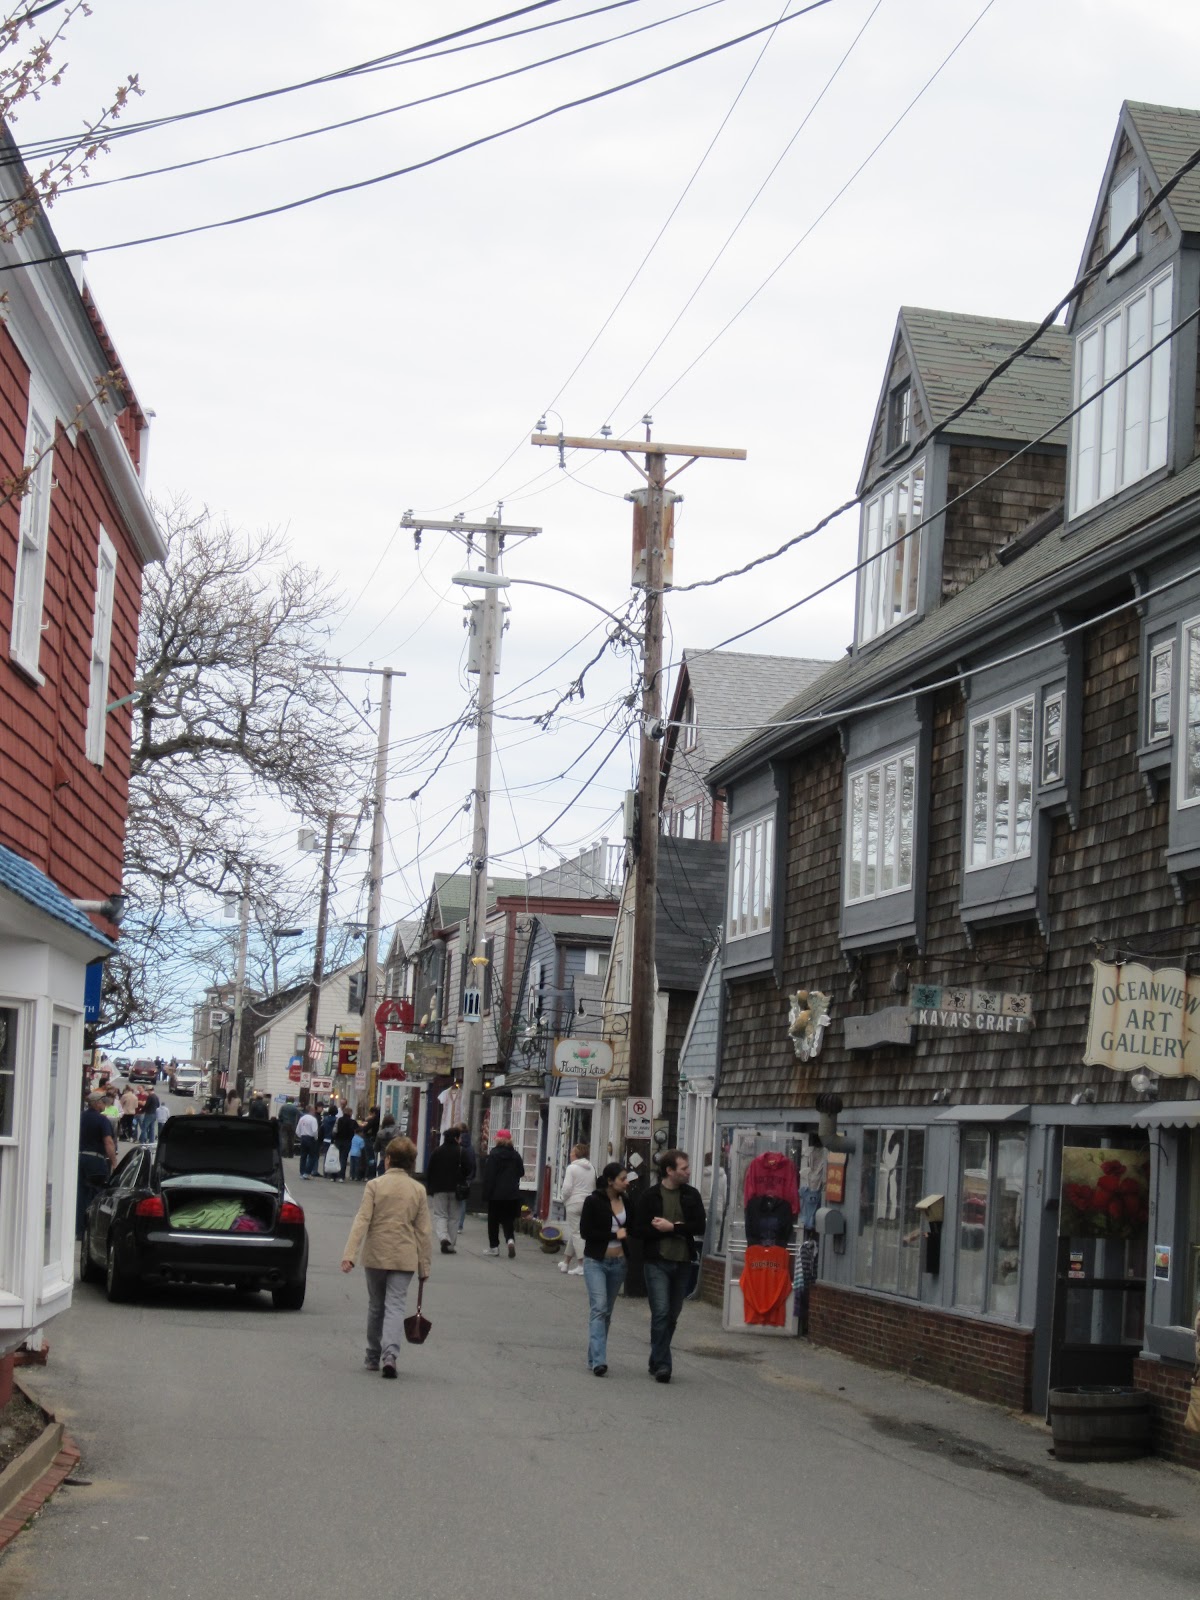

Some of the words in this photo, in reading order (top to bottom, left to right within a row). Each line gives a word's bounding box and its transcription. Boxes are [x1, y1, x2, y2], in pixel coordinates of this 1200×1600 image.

[1102, 981, 1200, 1015] OCEANVIEW
[919, 1009, 971, 1029] KAYA'S
[975, 1013, 1025, 1033] CRAFT
[1125, 1008, 1174, 1033] ART
[1100, 1030, 1191, 1059] GALLERY
[559, 1060, 587, 1077] Floating
[589, 1064, 606, 1076] Lotus
